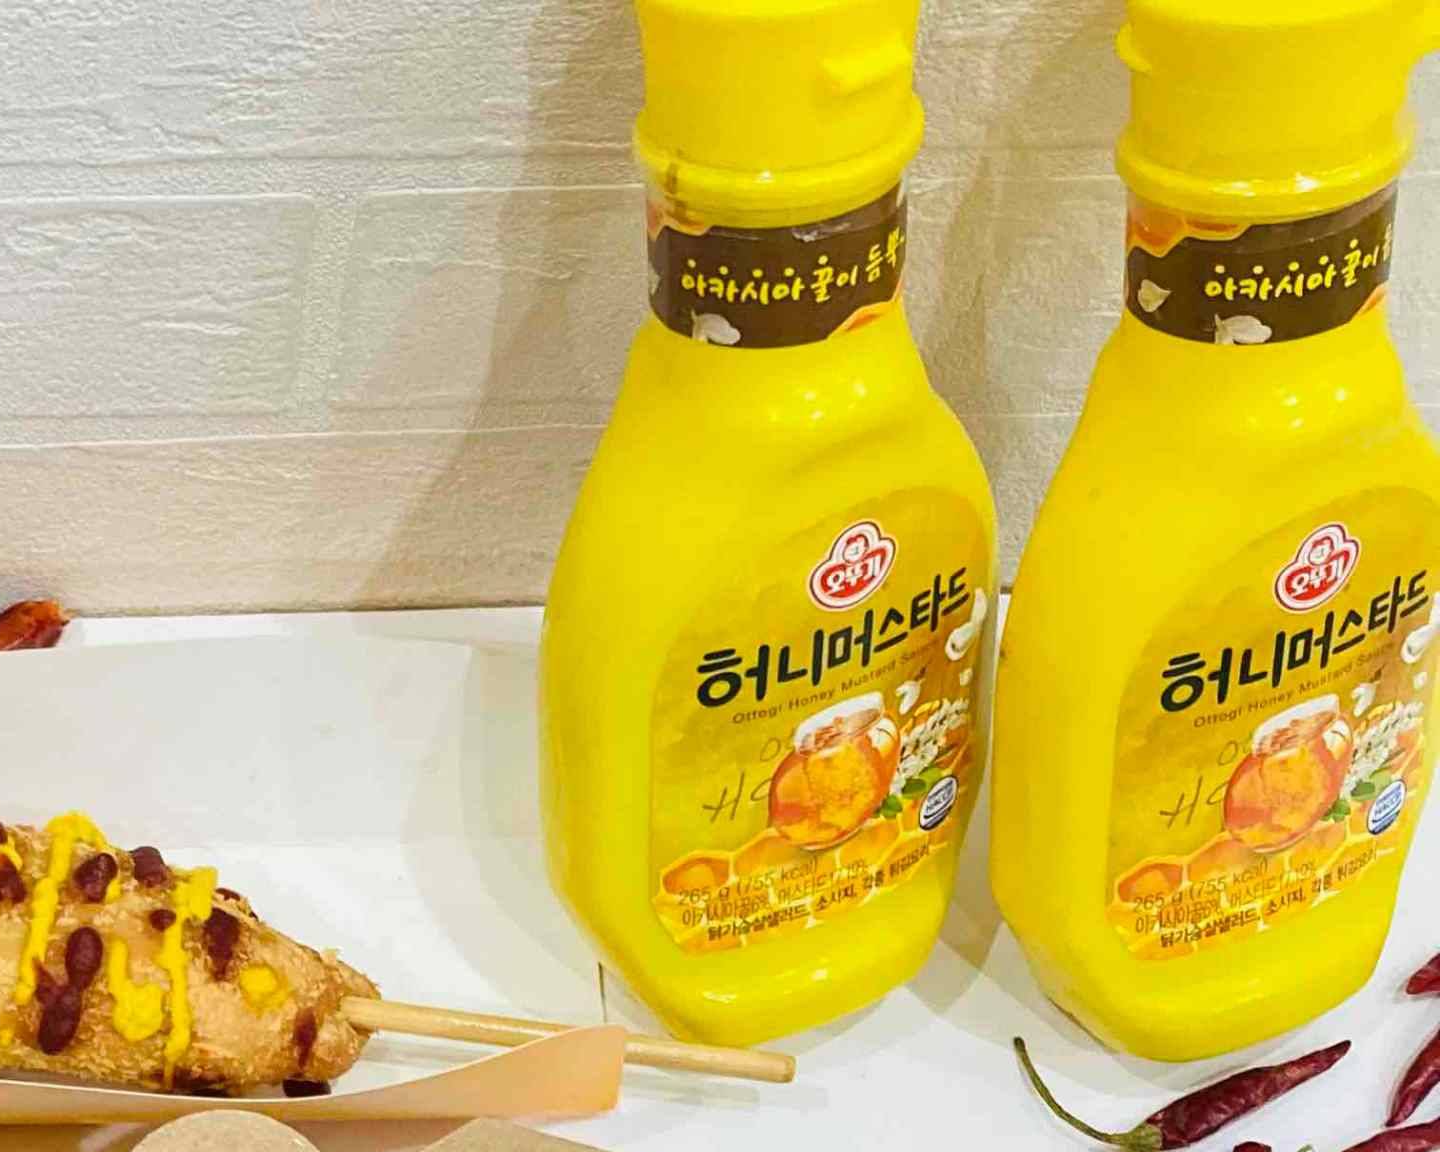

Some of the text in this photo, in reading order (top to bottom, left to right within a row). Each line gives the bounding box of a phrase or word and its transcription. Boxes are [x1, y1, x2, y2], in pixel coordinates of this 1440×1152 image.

[681, 264, 805, 305] 아카시아
[809, 259, 858, 303] 꿀이
[1204, 261, 1337, 301] 아카시아
[824, 554, 883, 595] 오뚜기
[1289, 555, 1347, 597] 오뚜기
[696, 566, 971, 708] 허니머스타드
[1160, 568, 1430, 713] 허니머스타드
[787, 687, 836, 712] Honey
[840, 660, 897, 692] Mustard
[1246, 689, 1294, 714] Honey
[679, 886, 711, 907] 265
[1132, 890, 1164, 914] 265
